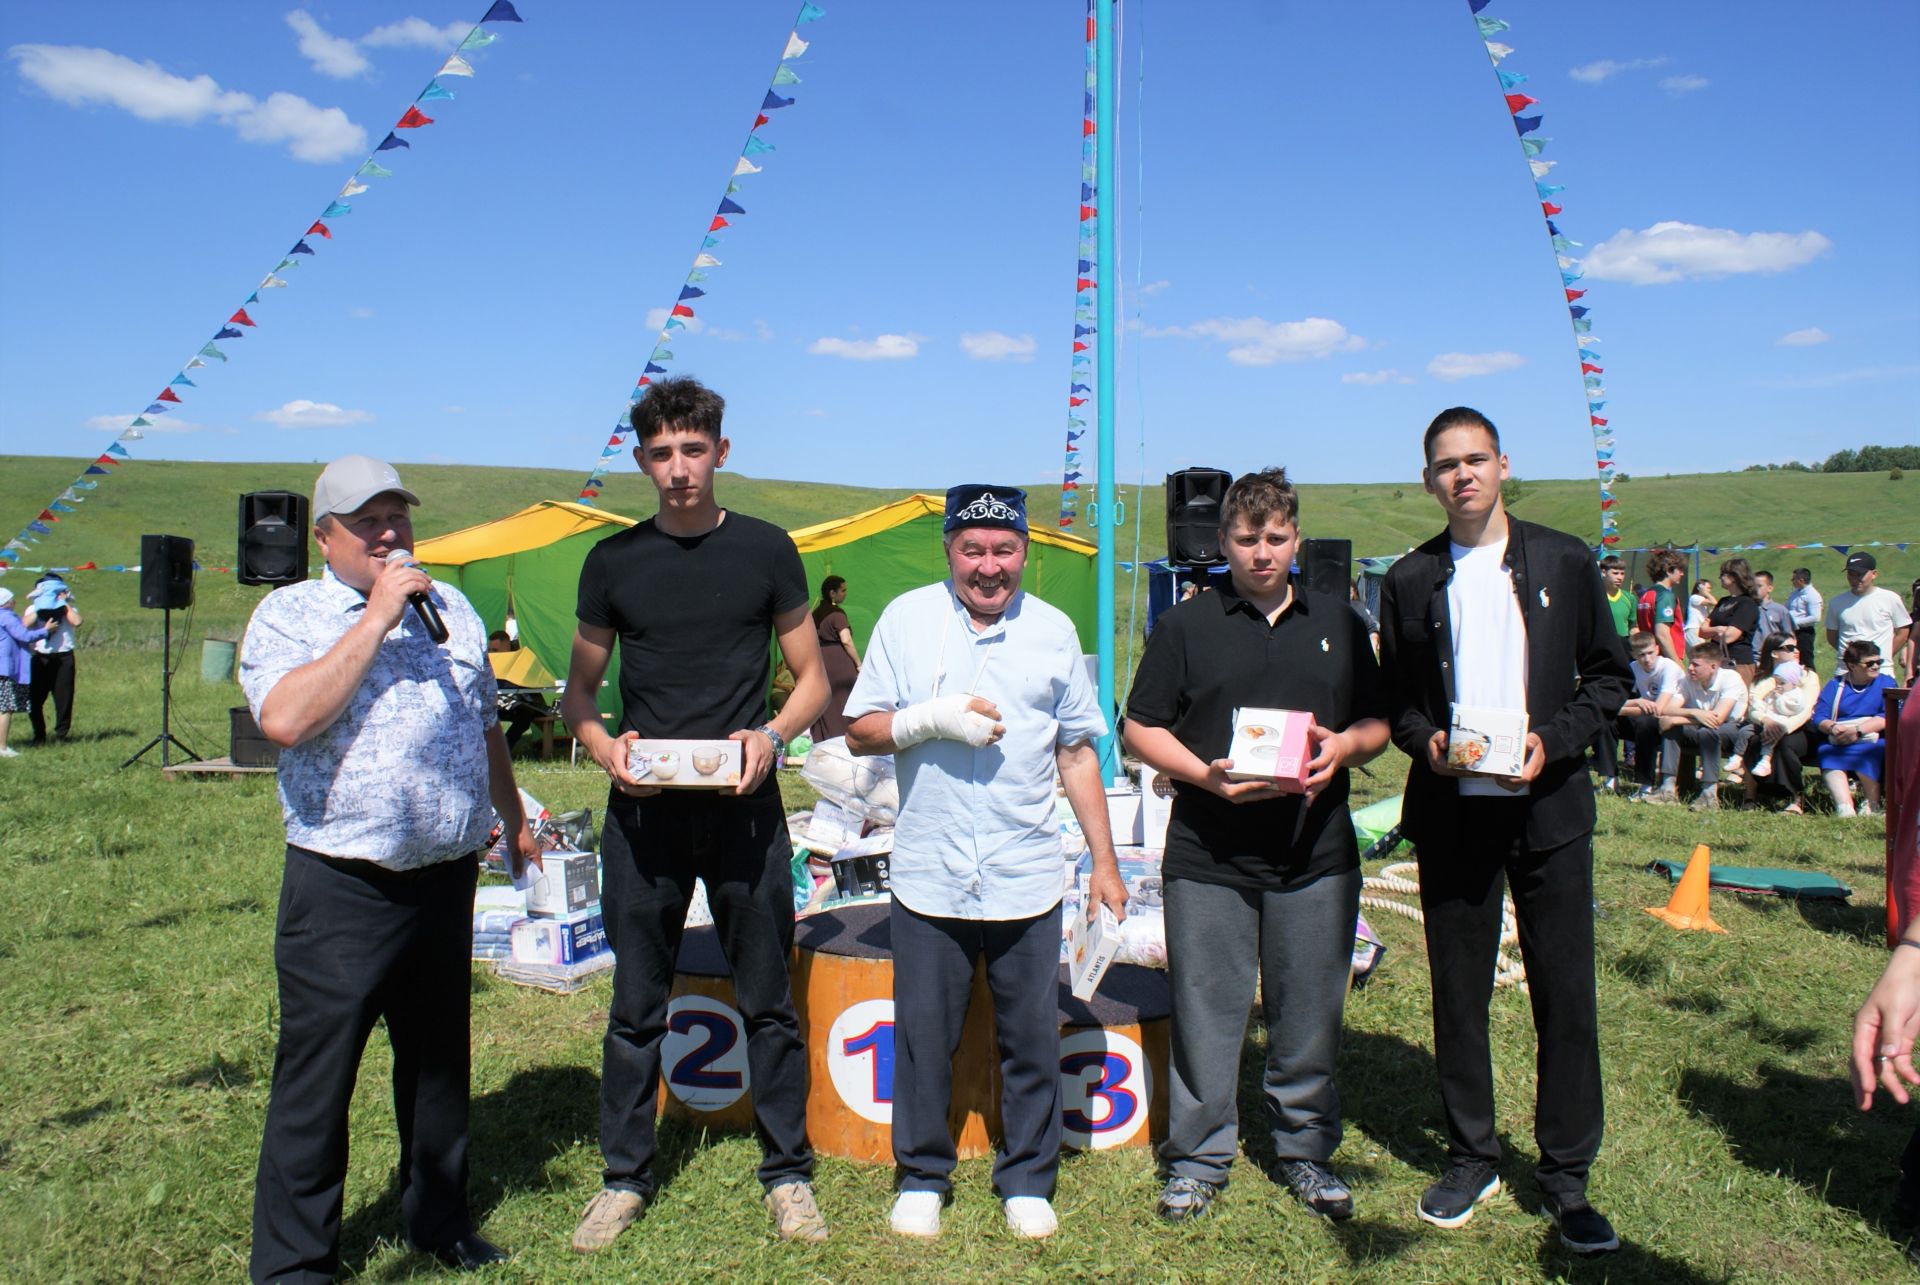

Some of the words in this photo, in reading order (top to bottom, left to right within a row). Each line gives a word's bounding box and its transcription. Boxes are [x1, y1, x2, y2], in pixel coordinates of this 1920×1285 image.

[668, 1010, 743, 1089] 2
[843, 1021, 896, 1103] 1
[1059, 1051, 1138, 1134] 3
